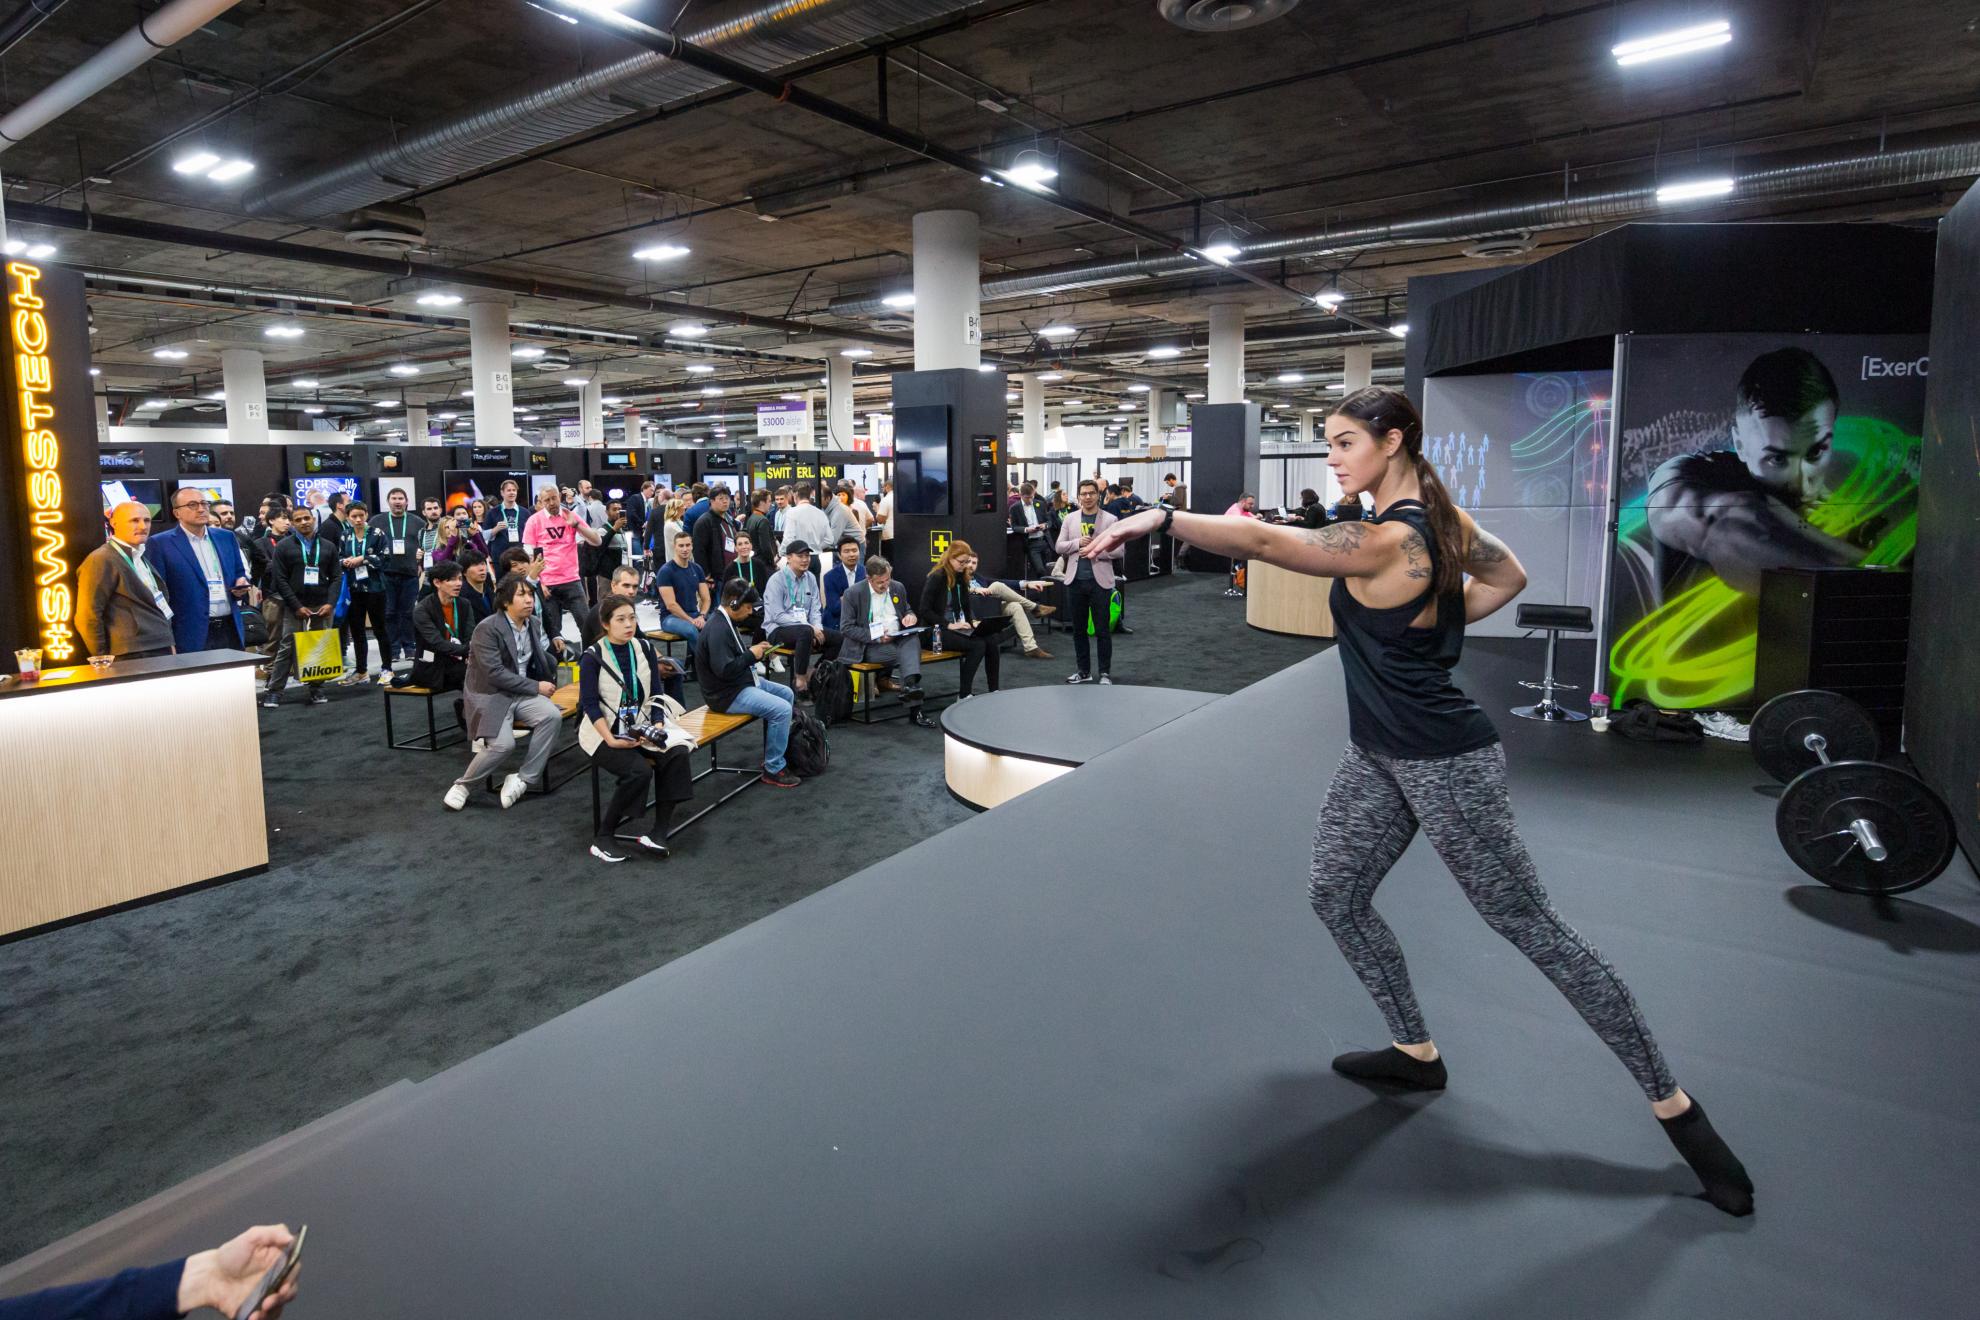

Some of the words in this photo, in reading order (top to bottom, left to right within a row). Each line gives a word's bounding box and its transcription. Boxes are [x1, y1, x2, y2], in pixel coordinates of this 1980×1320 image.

[763, 416, 785, 427] S3000
[785, 415, 802, 426] aisle
[9, 261, 73, 660] #SWISSTECH
[473, 453, 508, 461] RayShaper
[295, 479, 329, 489] GDPR
[301, 664, 341, 678] Nikon
